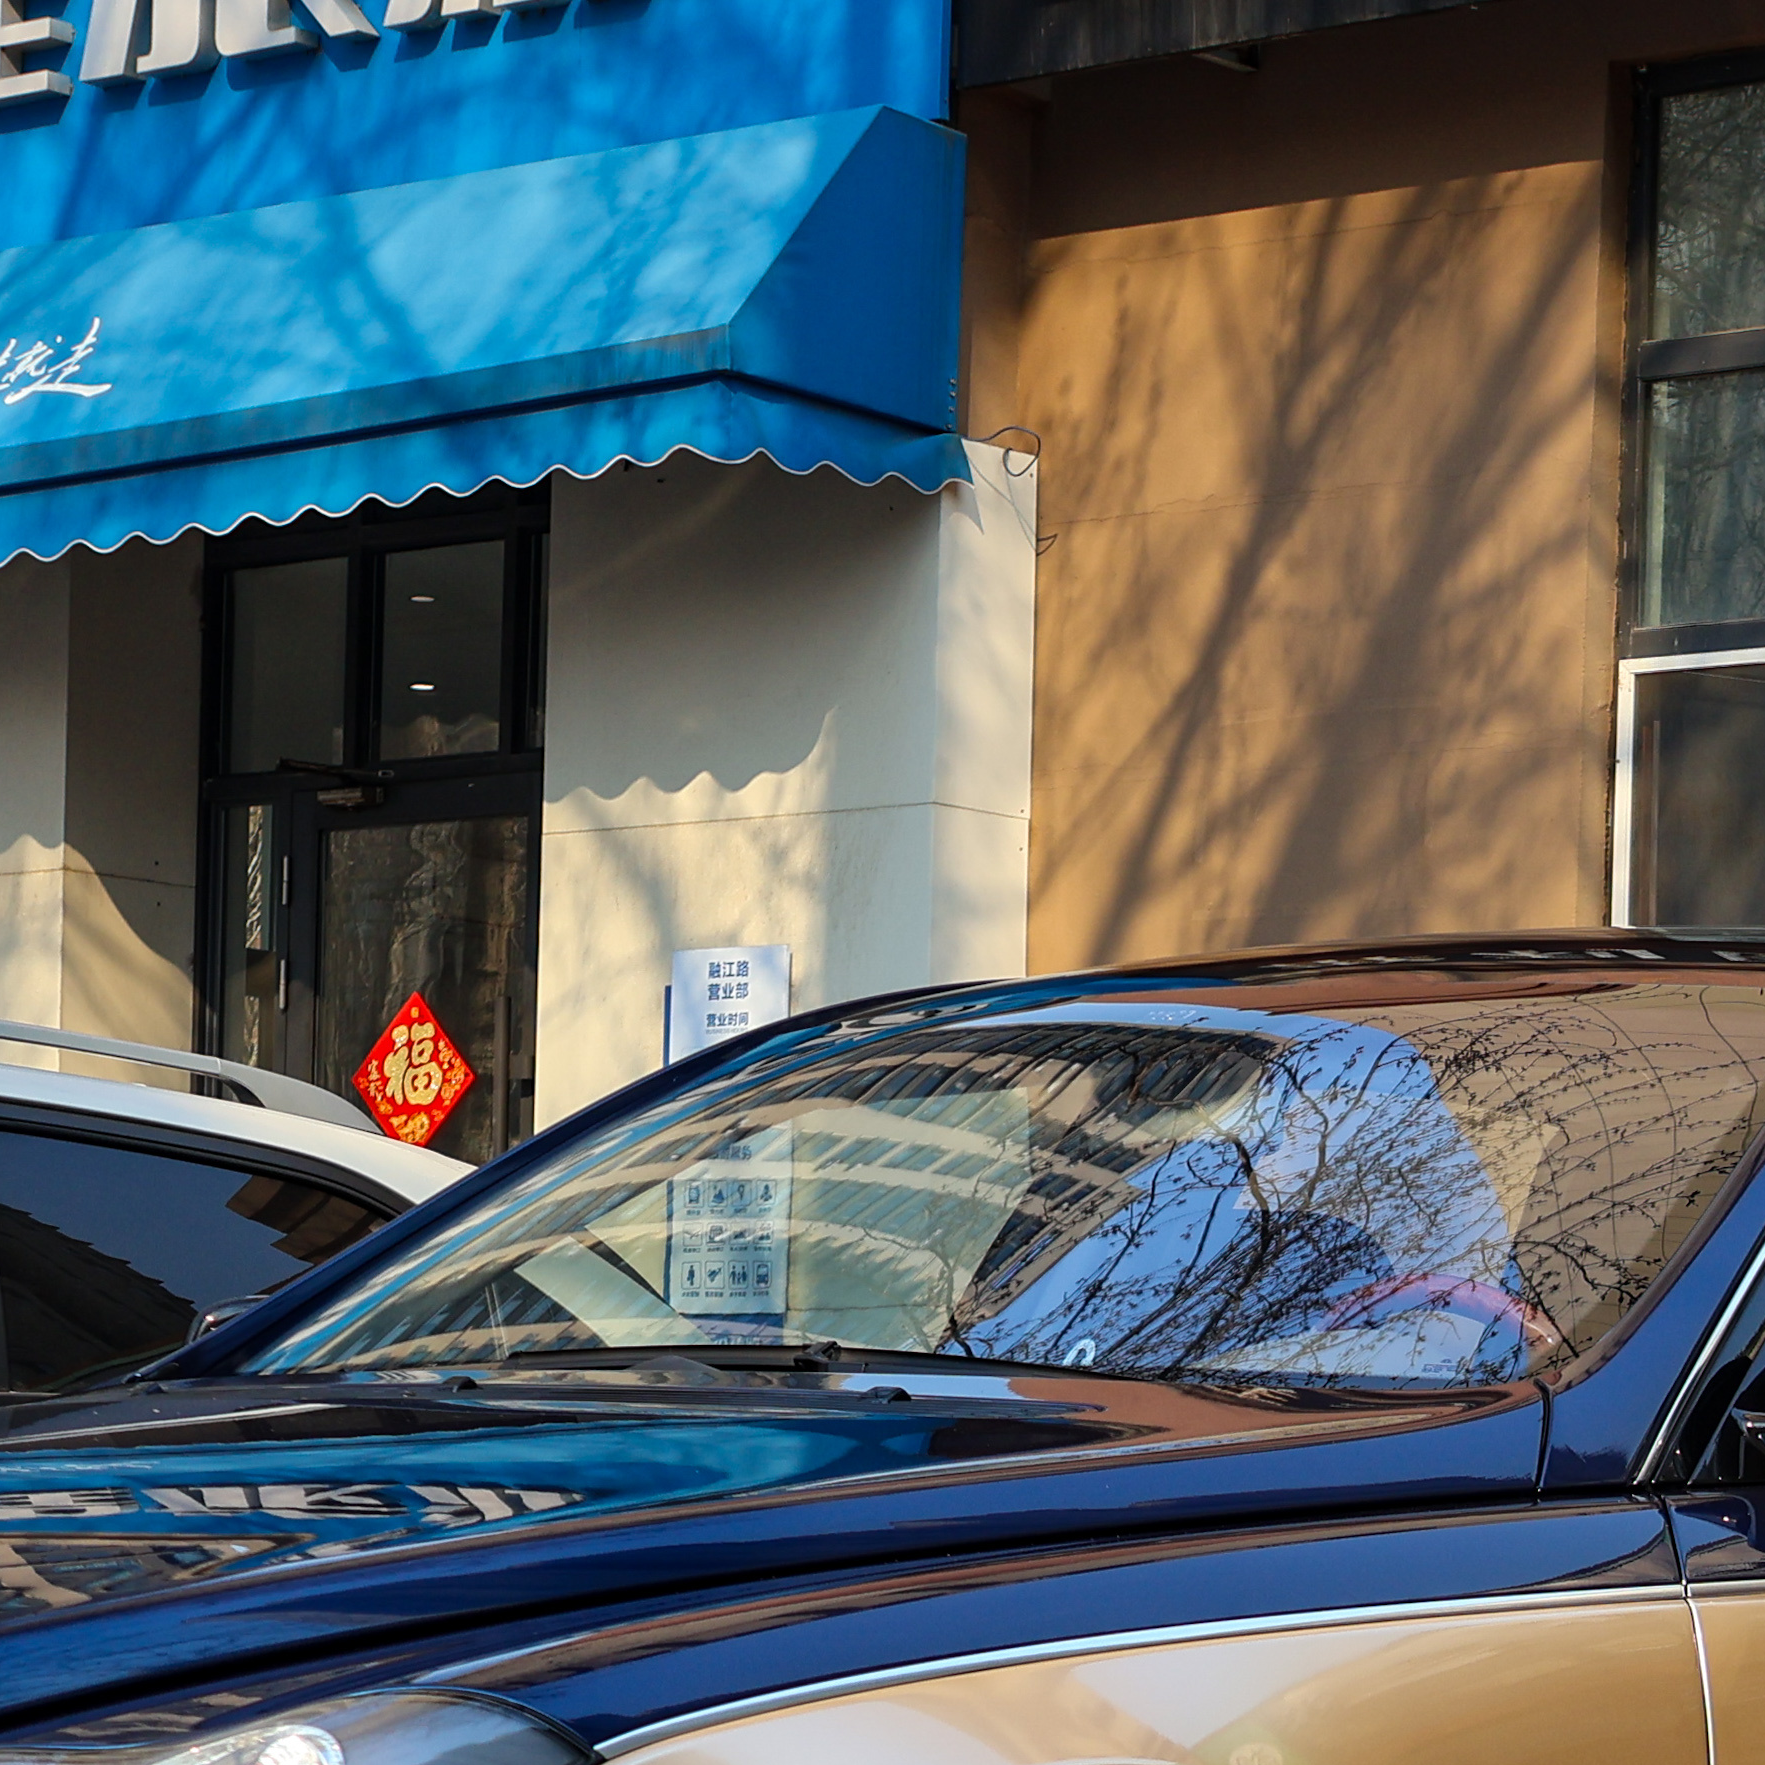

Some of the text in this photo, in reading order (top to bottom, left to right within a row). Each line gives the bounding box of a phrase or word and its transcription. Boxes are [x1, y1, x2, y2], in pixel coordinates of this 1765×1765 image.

[708, 983, 749, 1001] 营业部
[706, 1011, 749, 1028] 营业时间
[384, 1022, 443, 1106] 福
